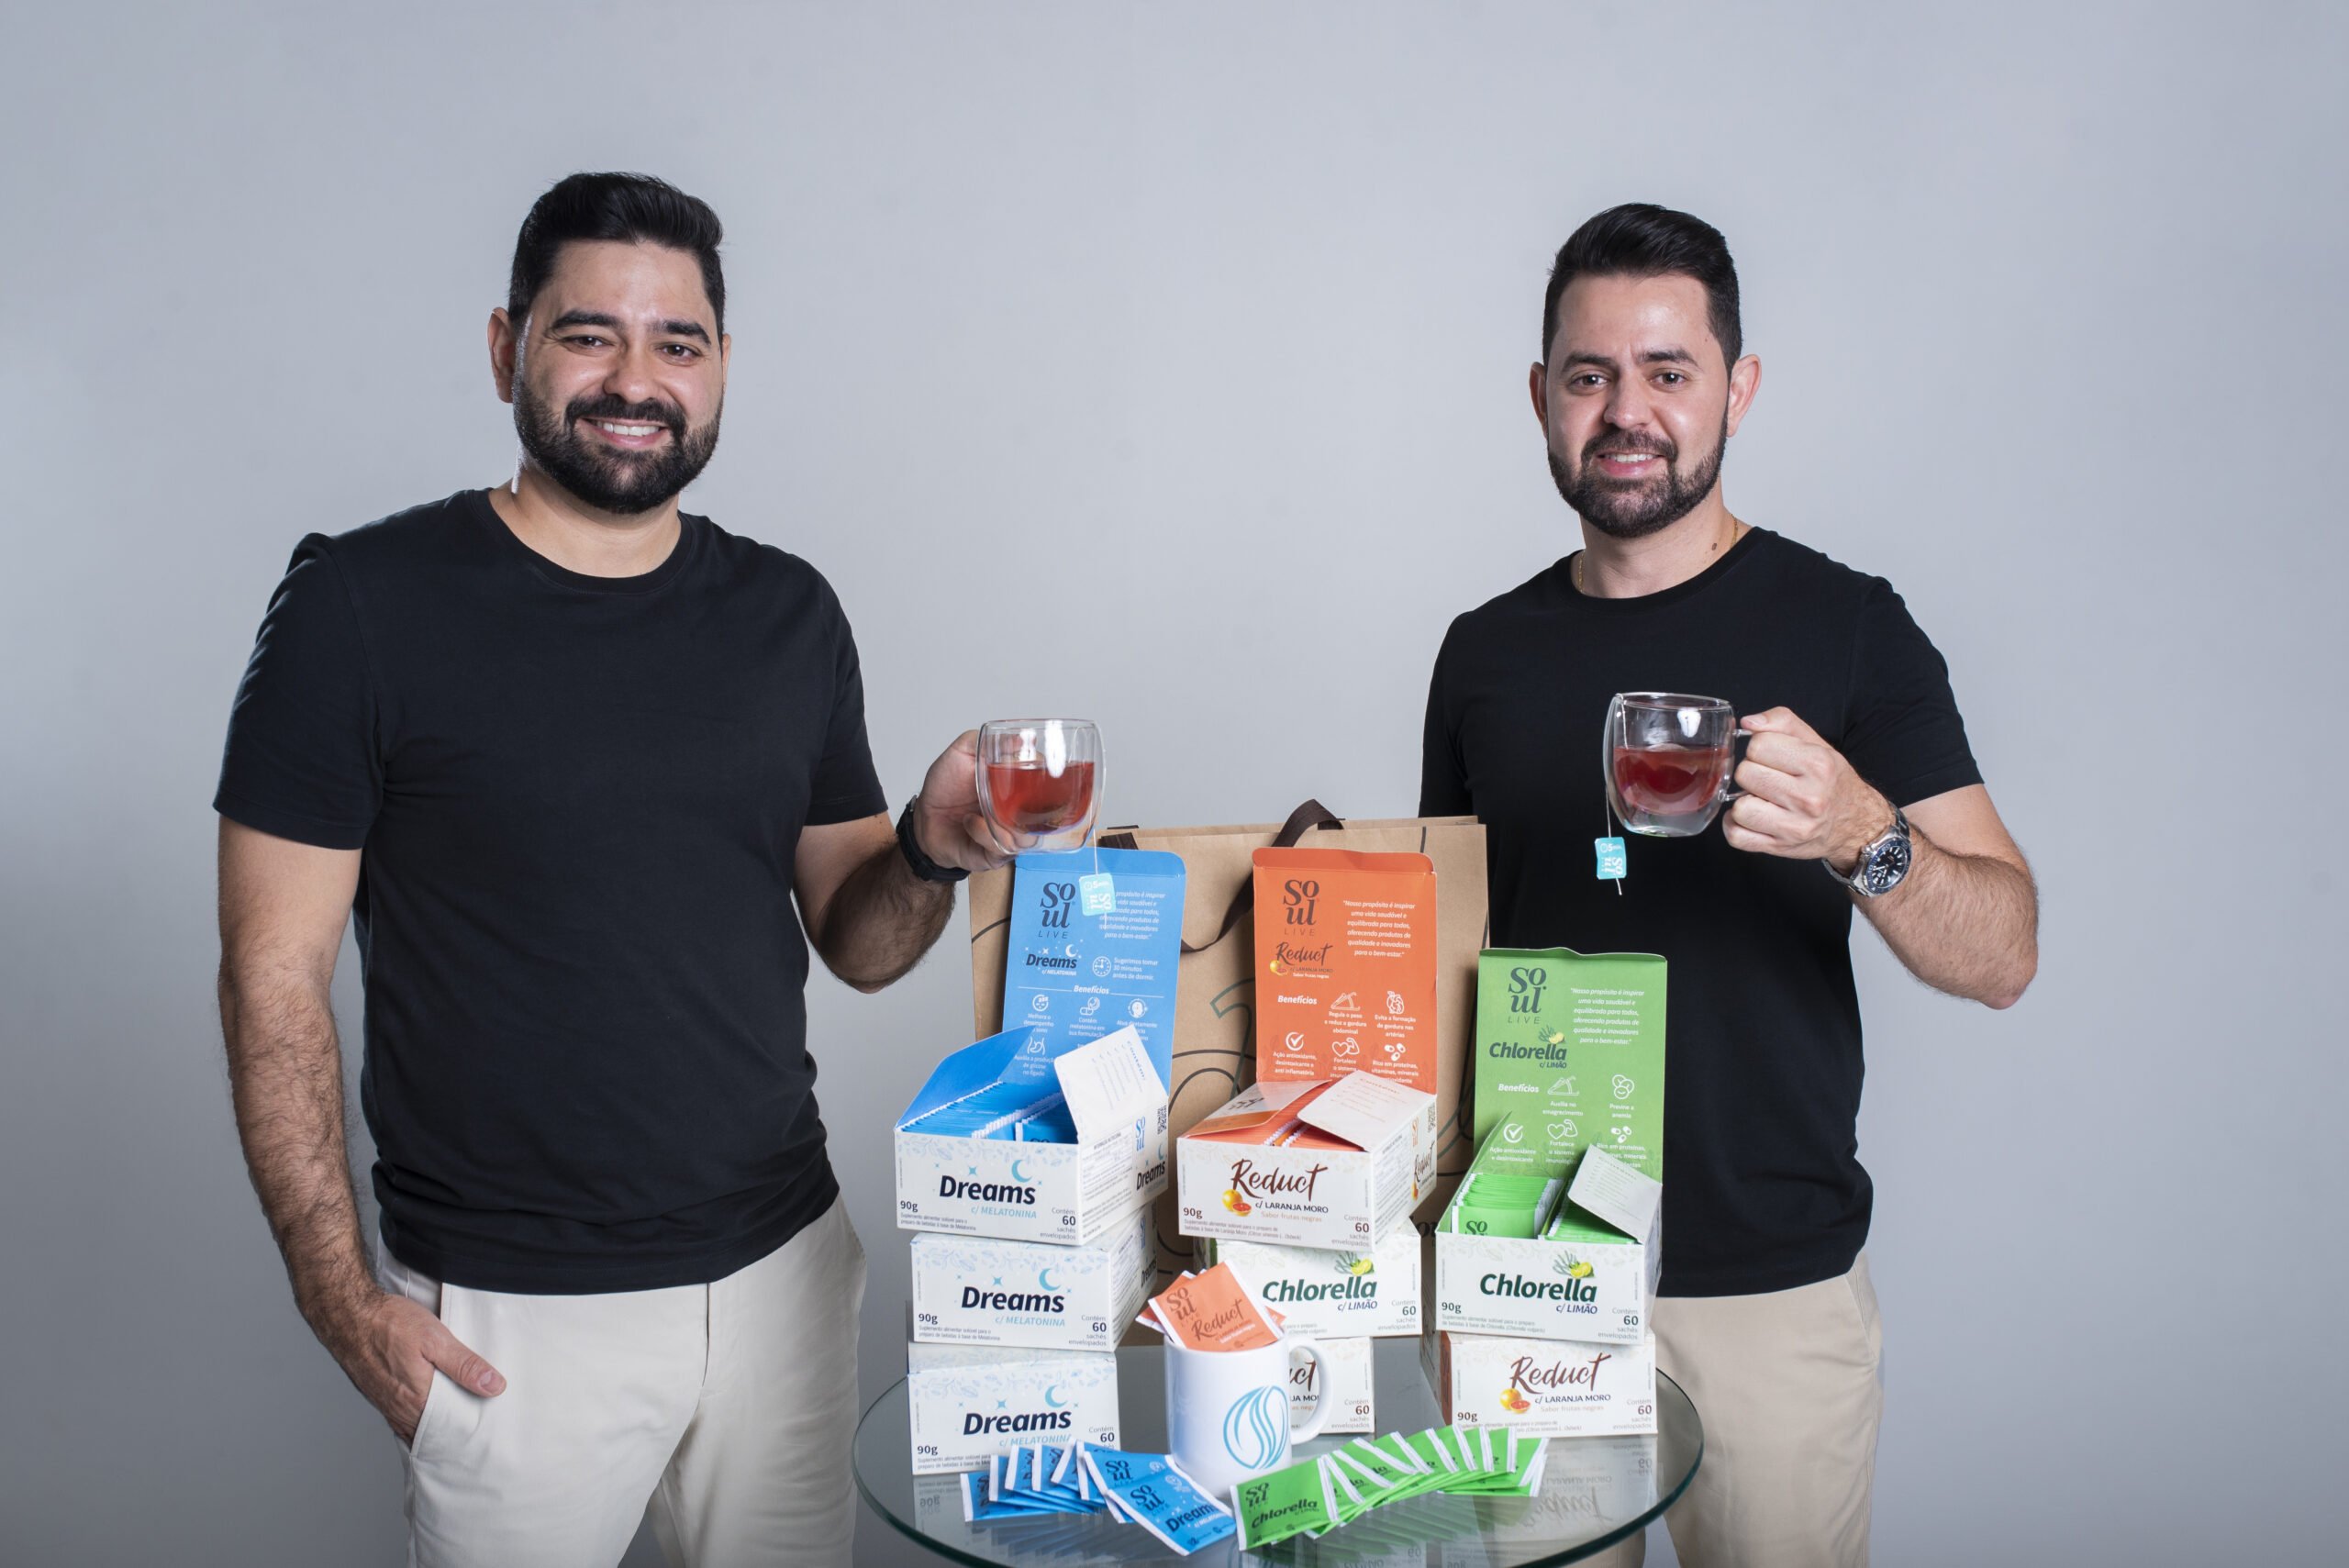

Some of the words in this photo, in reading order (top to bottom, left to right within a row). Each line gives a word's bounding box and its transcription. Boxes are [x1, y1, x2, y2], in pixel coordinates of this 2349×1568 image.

[1041, 882, 1075, 908] So
[1284, 880, 1319, 906] So
[1042, 902, 1070, 929] ul
[1286, 899, 1317, 925] ul
[1038, 930, 1068, 939] LIVE
[1285, 929, 1315, 937] LIVE
[1378, 930, 1402, 939] produtos
[1348, 939, 1375, 947] qualidade
[1276, 941, 1333, 966] Reduct
[1026, 953, 1077, 969] Dreams
[1508, 967, 1546, 994] So
[1074, 984, 1108, 995] Benefícios
[1590, 988, 1617, 996] propósito
[1277, 995, 1317, 1005] Benefícios
[1511, 986, 1542, 1013] ul
[1489, 1042, 1567, 1061] Chlorella
[1498, 1084, 1539, 1093] Benefícios
[1137, 1162, 1165, 1191] Dreams
[1230, 1158, 1328, 1201] Reduct
[940, 1175, 1035, 1205] Dreams
[900, 1200, 918, 1212] 90g
[1052, 1207, 1075, 1215] Contém
[1255, 1201, 1264, 1209] c/
[1265, 1202, 1302, 1211] LARANJA
[1304, 1204, 1329, 1214] MORO
[981, 1207, 1037, 1219] MELATONINA
[1183, 1207, 1203, 1219] 90g
[1301, 1214, 1321, 1222] negras
[1344, 1214, 1369, 1222] Contém
[1062, 1216, 1075, 1226] 60
[1355, 1222, 1370, 1233] 60
[1040, 1232, 1076, 1240] envelopados
[1331, 1239, 1370, 1247] envelopados
[1263, 1275, 1377, 1303] Chlorella
[1480, 1273, 1597, 1303] Chlorella
[962, 1286, 1065, 1313] Dreams
[1167, 1287, 1188, 1311] So
[1338, 1302, 1347, 1312] c/
[1348, 1299, 1378, 1311] LIMÃO
[1442, 1302, 1462, 1314] 90g
[1556, 1304, 1565, 1313] c/
[1566, 1303, 1598, 1315] LIMÃO
[1402, 1307, 1417, 1316] 60
[918, 1313, 939, 1325] 90g
[1006, 1316, 1065, 1327] MELATONINA
[1191, 1299, 1243, 1341] Reduct
[1623, 1316, 1639, 1326] 60
[1092, 1322, 1107, 1332] 60
[1377, 1323, 1416, 1331] envelopados
[1598, 1331, 1638, 1340] envelopados
[1509, 1352, 1612, 1394] Reduct
[1535, 1396, 1543, 1404] c/
[1545, 1395, 1585, 1404] LARANJA
[1586, 1394, 1611, 1402] MORO
[1355, 1405, 1370, 1415] 60
[1541, 1405, 1560, 1413] Sabor
[1638, 1405, 1653, 1416] 60
[963, 1410, 1072, 1435] Dreams
[1457, 1412, 1478, 1422] 90g
[1613, 1422, 1653, 1430] envelopados
[1100, 1432, 1115, 1442] 60
[999, 1439, 1008, 1447] c/
[917, 1445, 939, 1455] 90g
[1105, 1460, 1129, 1473] So
[1130, 1485, 1152, 1506] So
[1252, 1499, 1318, 1529] Chlorella
